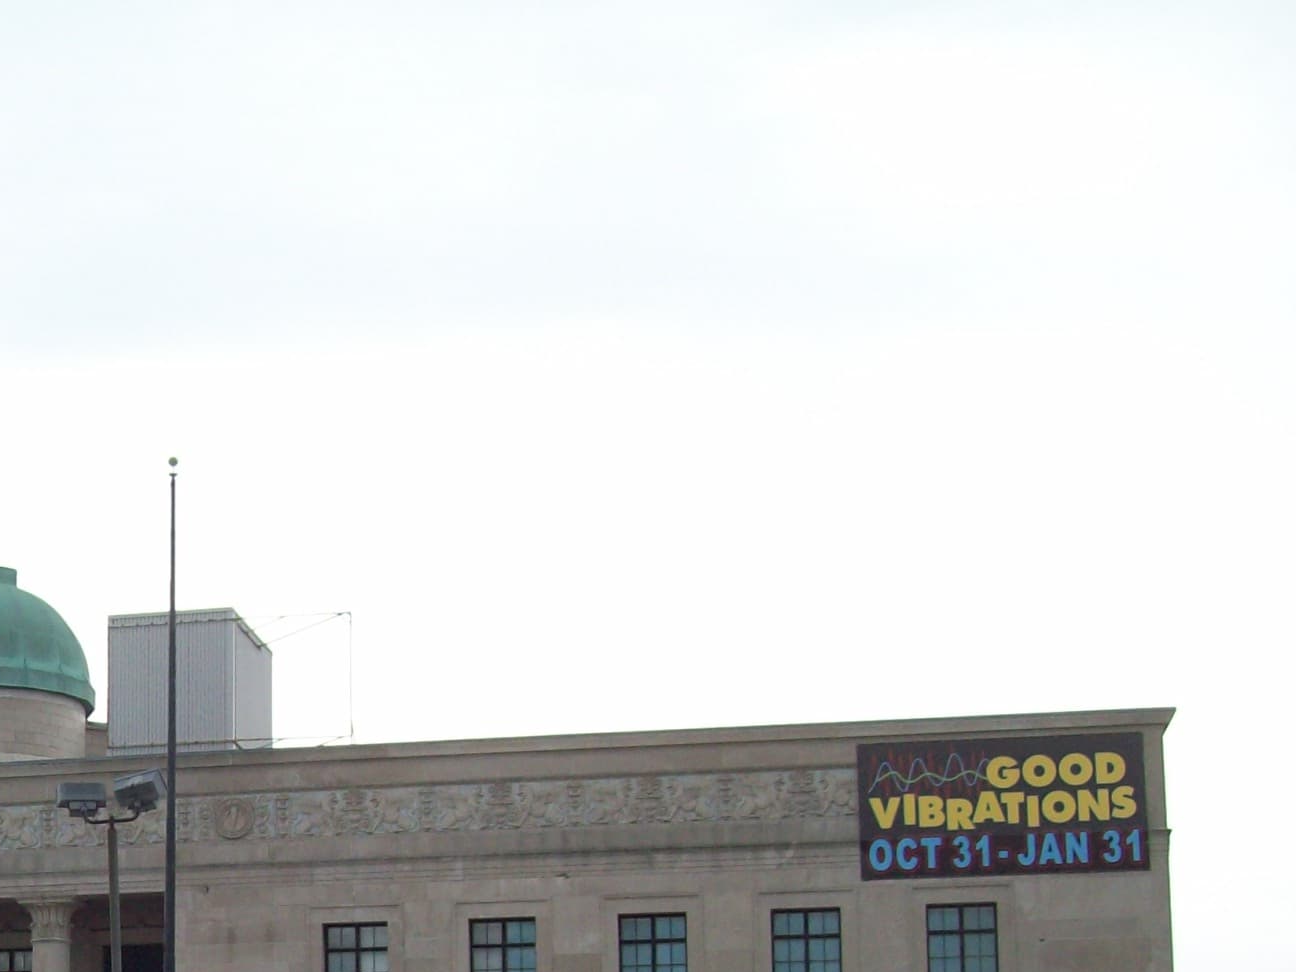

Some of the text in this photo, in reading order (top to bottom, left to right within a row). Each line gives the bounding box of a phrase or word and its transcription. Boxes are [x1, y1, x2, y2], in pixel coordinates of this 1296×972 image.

[986, 752, 1126, 789] GOOD
[869, 785, 1138, 831] VIBRATIONS
[868, 836, 943, 872] OCT
[953, 834, 992, 870] 31
[1017, 831, 1089, 867] JAN
[1103, 829, 1143, 864] 31
